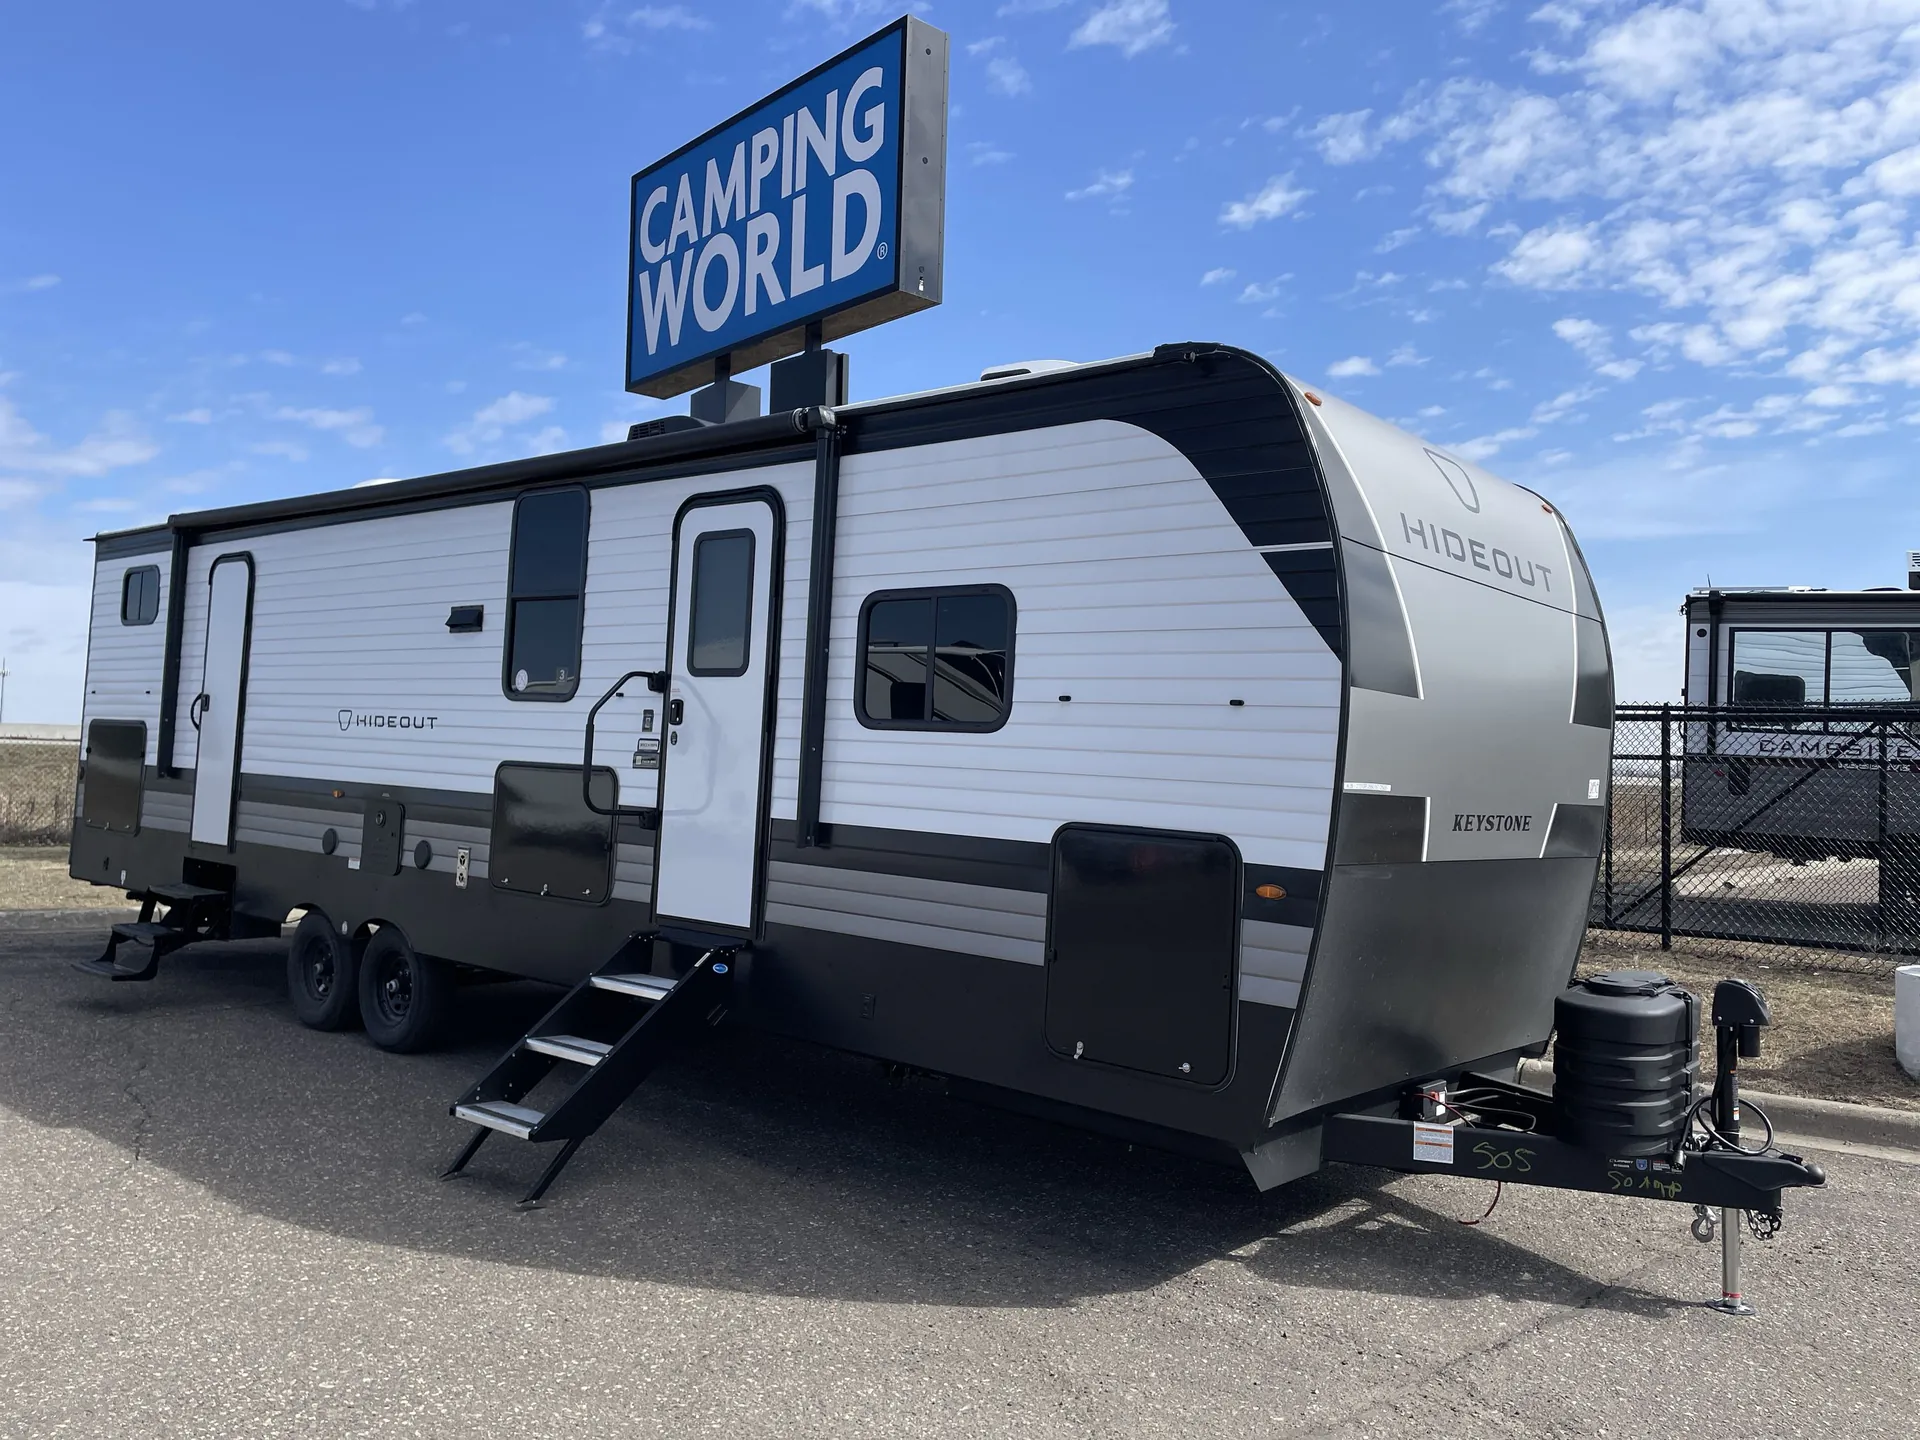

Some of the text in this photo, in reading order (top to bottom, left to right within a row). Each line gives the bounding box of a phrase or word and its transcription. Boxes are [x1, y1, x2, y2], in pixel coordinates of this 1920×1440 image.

[640, 66, 885, 264] CAMPING
[639, 168, 882, 356] WORLD
[1400, 512, 1552, 592] HIDEOUT
[558, 669, 565, 680] 3
[356, 715, 438, 730] HIDEOUT
[1759, 739, 1913, 759] CAMPSIE
[1452, 814, 1532, 832] KEYSTONE
